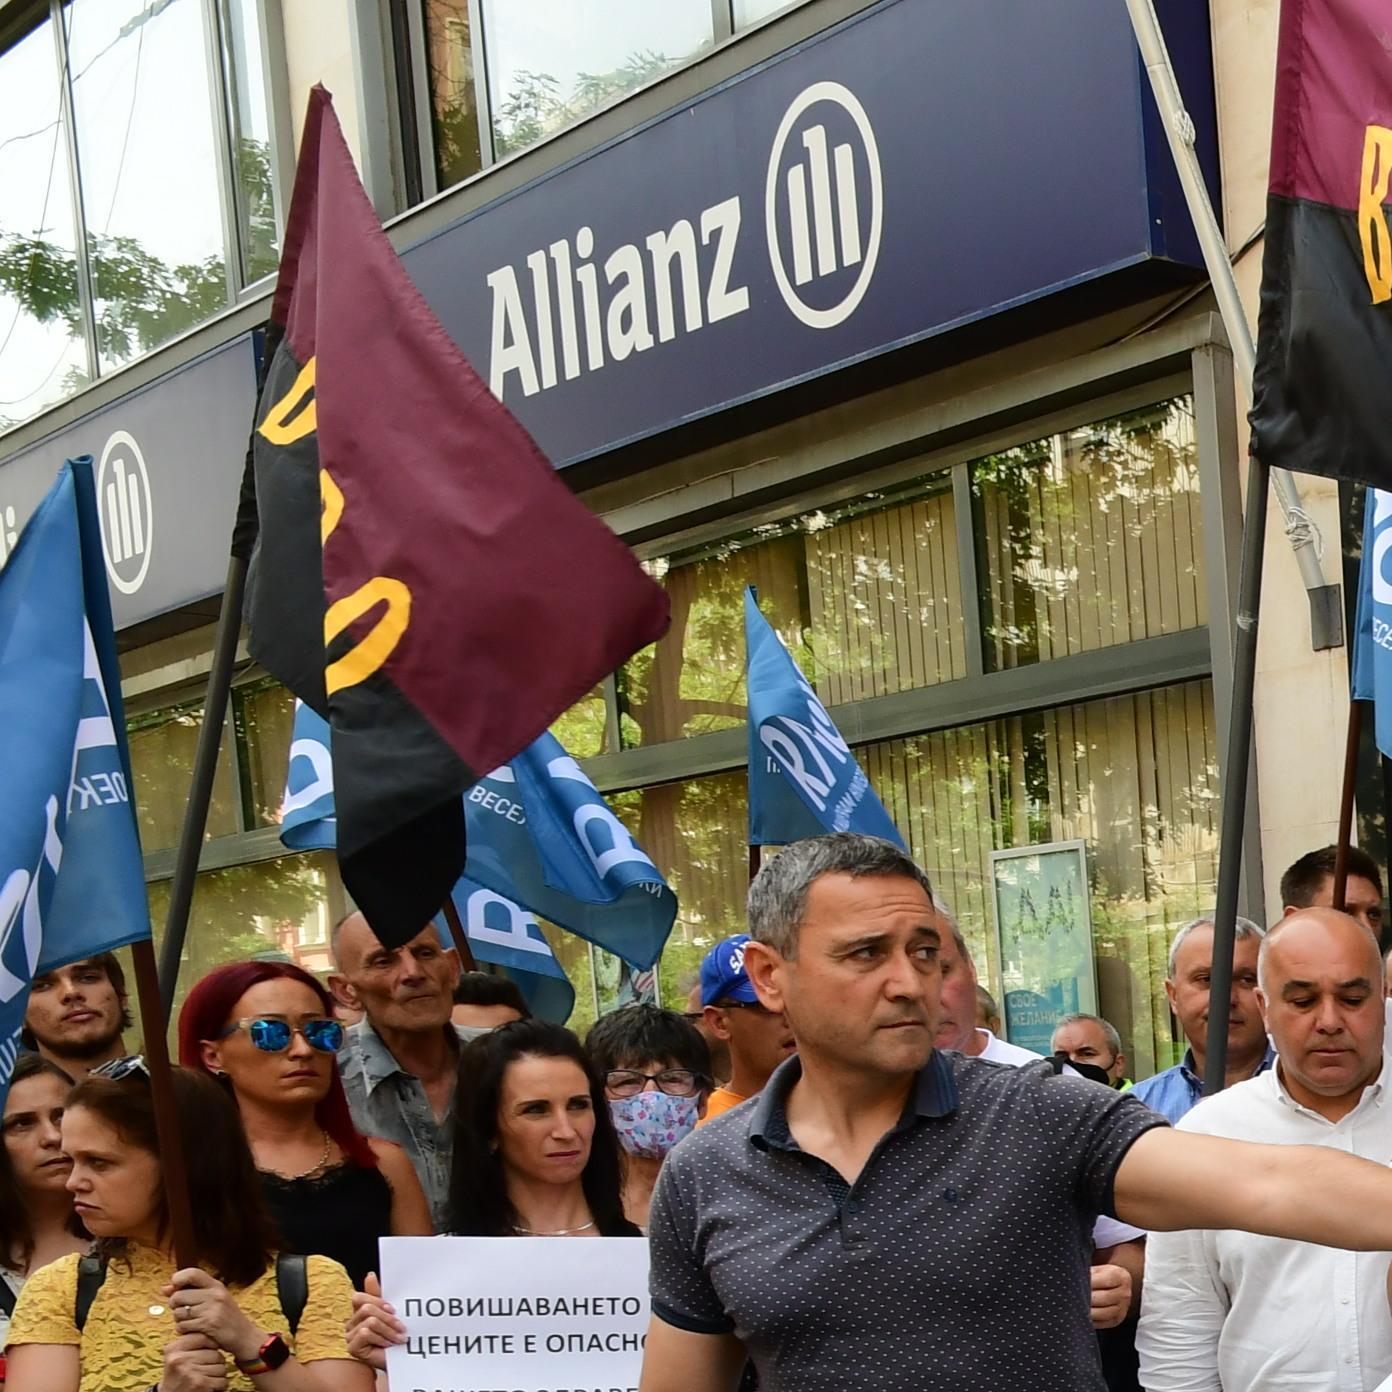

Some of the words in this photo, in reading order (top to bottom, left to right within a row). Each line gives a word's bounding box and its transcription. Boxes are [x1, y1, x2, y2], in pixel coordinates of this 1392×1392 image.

[486, 195, 751, 402] Allianz
[404, 1297, 641, 1318] ПОВИШАВАНЕТО
[405, 1334, 514, 1359] ЦЕНИТЕ
[524, 1334, 537, 1353] Е
